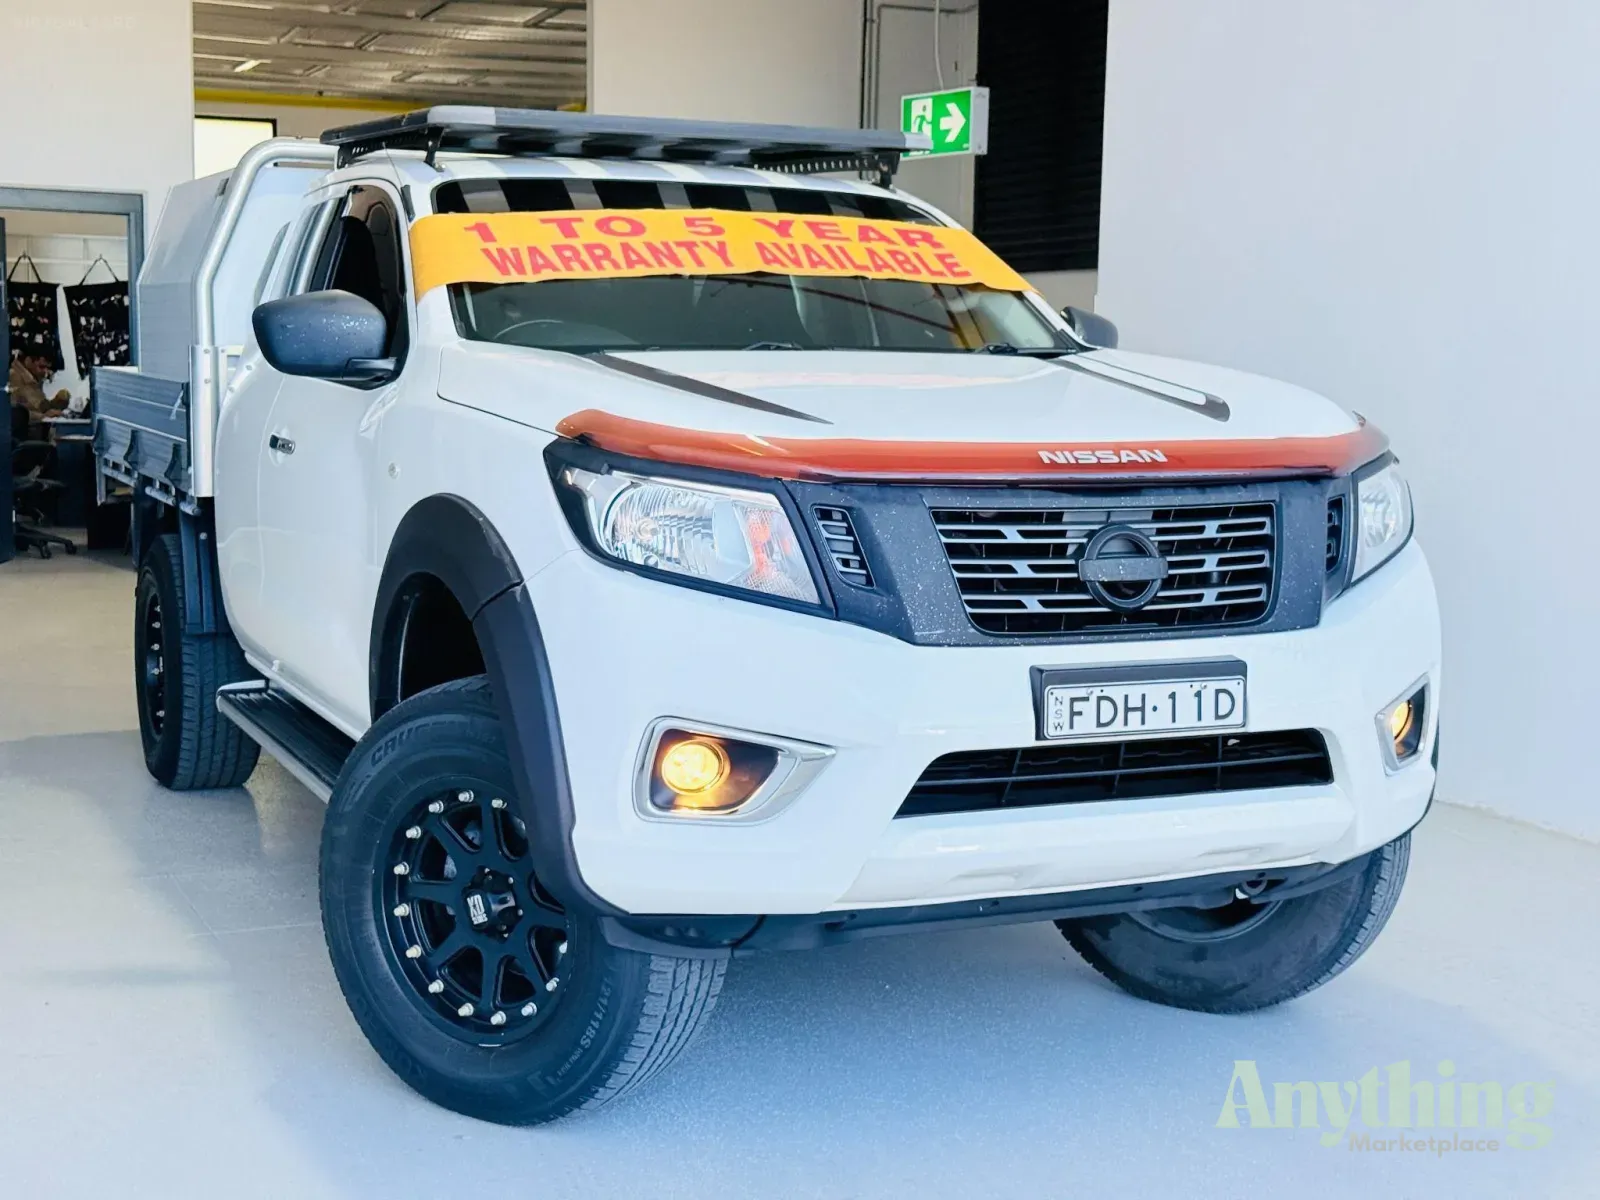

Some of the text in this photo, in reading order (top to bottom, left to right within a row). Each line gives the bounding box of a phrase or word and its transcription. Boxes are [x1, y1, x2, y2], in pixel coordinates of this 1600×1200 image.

[464, 216, 945, 249] 1 TO 5 YEAR
[480, 240, 972, 278] WARRANTY AVAILABLE
[1037, 449, 1168, 464] NISSAN
